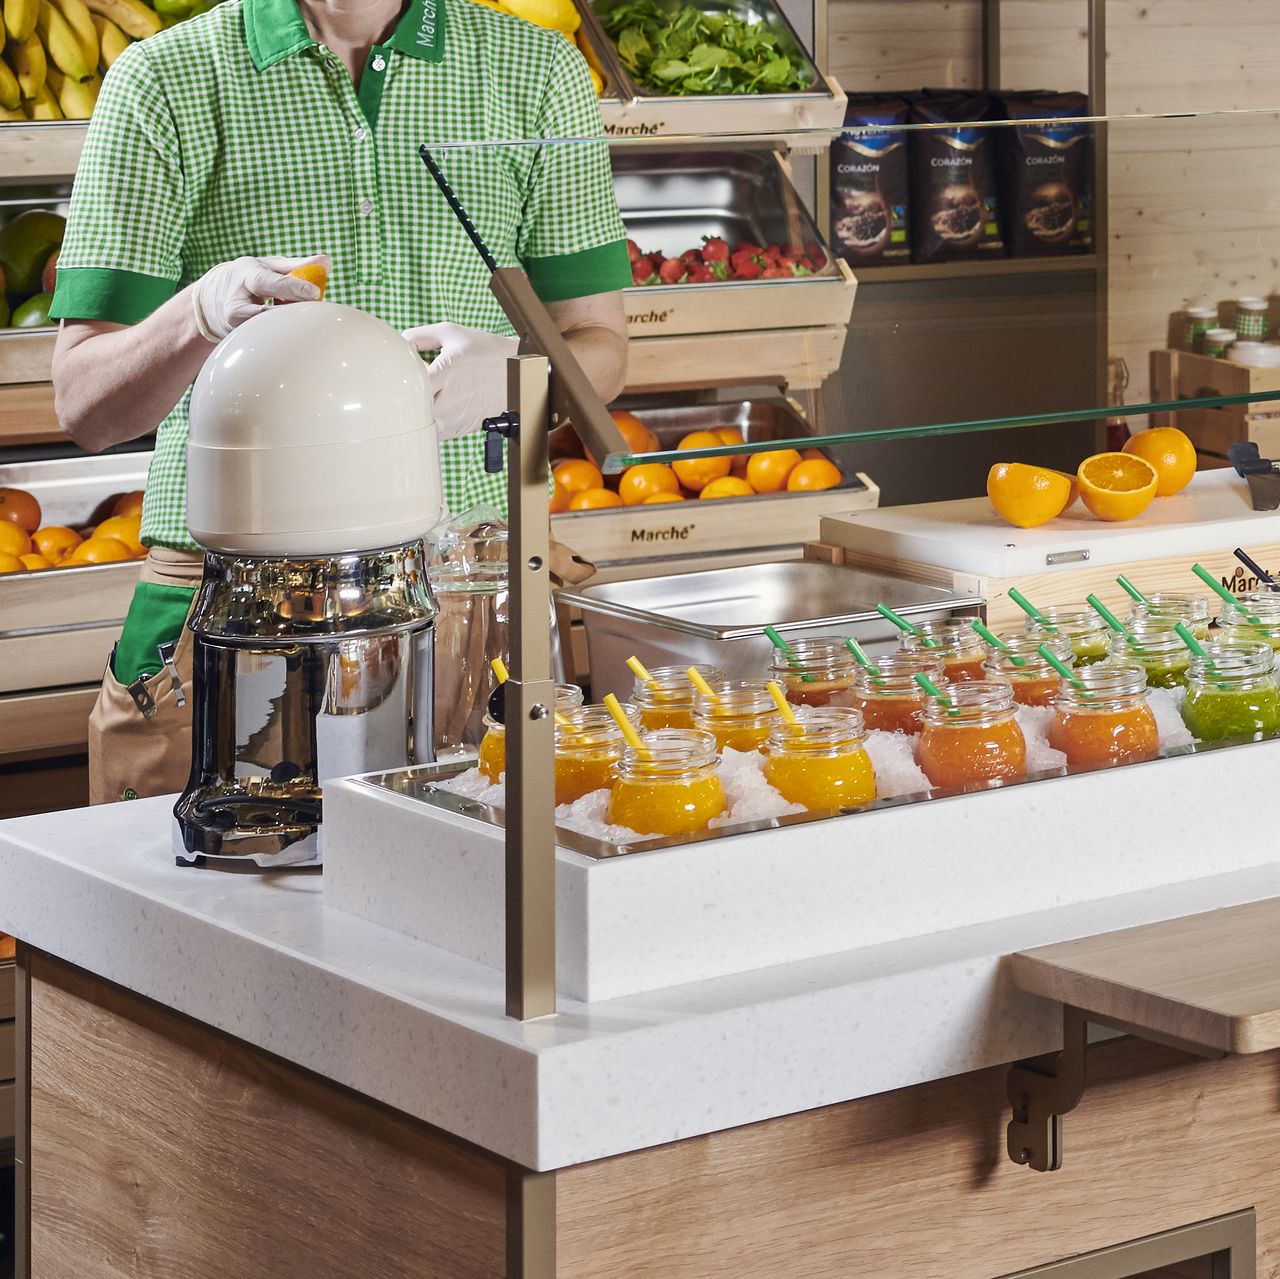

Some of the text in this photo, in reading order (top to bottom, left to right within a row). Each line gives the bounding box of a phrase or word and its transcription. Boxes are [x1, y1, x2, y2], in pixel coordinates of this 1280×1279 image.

[604, 122, 658, 135] Marché
[931, 157, 972, 168] CORAZÓN
[1026, 155, 1065, 166] CORAZÓN
[837, 163, 880, 174] CORAZÓN
[626, 310, 668, 324] arché
[631, 525, 689, 543] Marché
